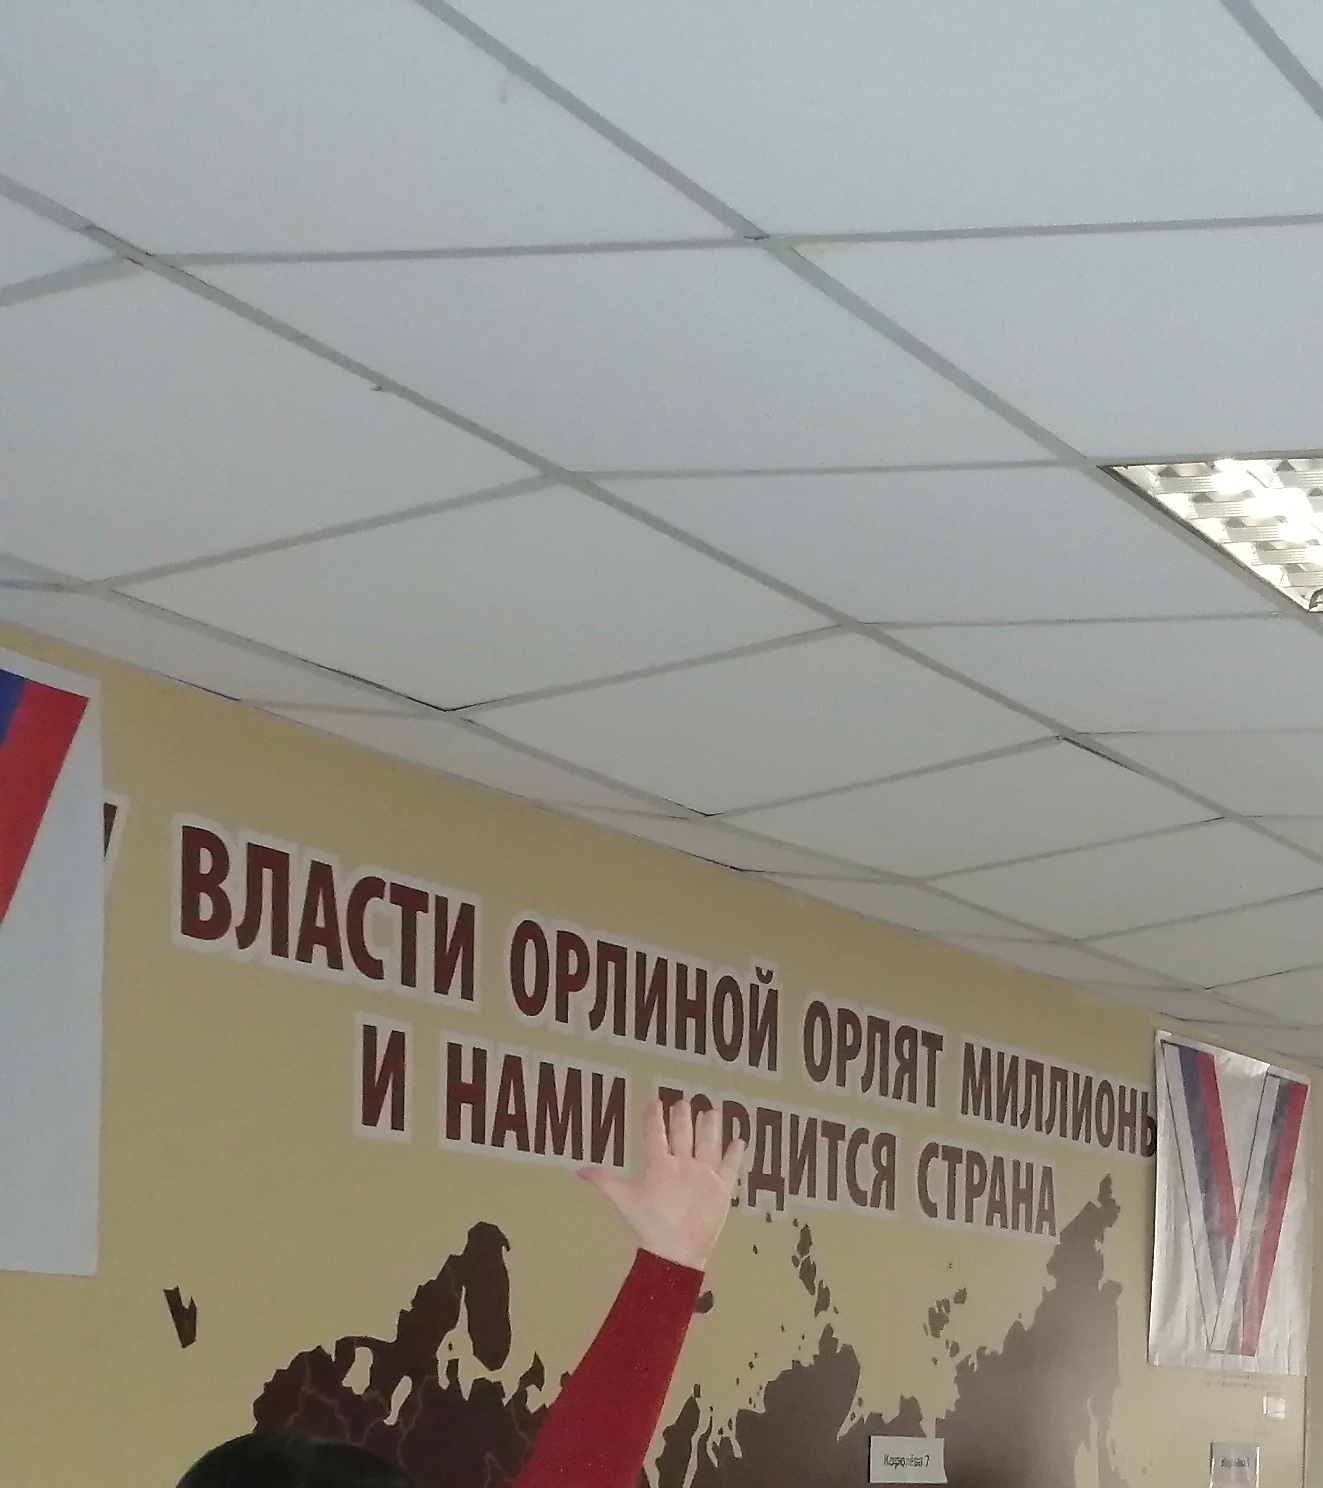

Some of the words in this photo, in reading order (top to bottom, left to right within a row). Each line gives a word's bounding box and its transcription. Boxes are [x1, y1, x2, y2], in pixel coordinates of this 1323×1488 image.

[181, 825, 475, 1001] ВЛАСТИ
[510, 919, 779, 1072] ОРЛИНОЙ
[802, 1000, 944, 1109] ОРЛЯТ
[362, 1024, 406, 1132] И
[446, 1042, 625, 1168] НАМИ
[917, 1141, 1057, 1237] СТРАНА
